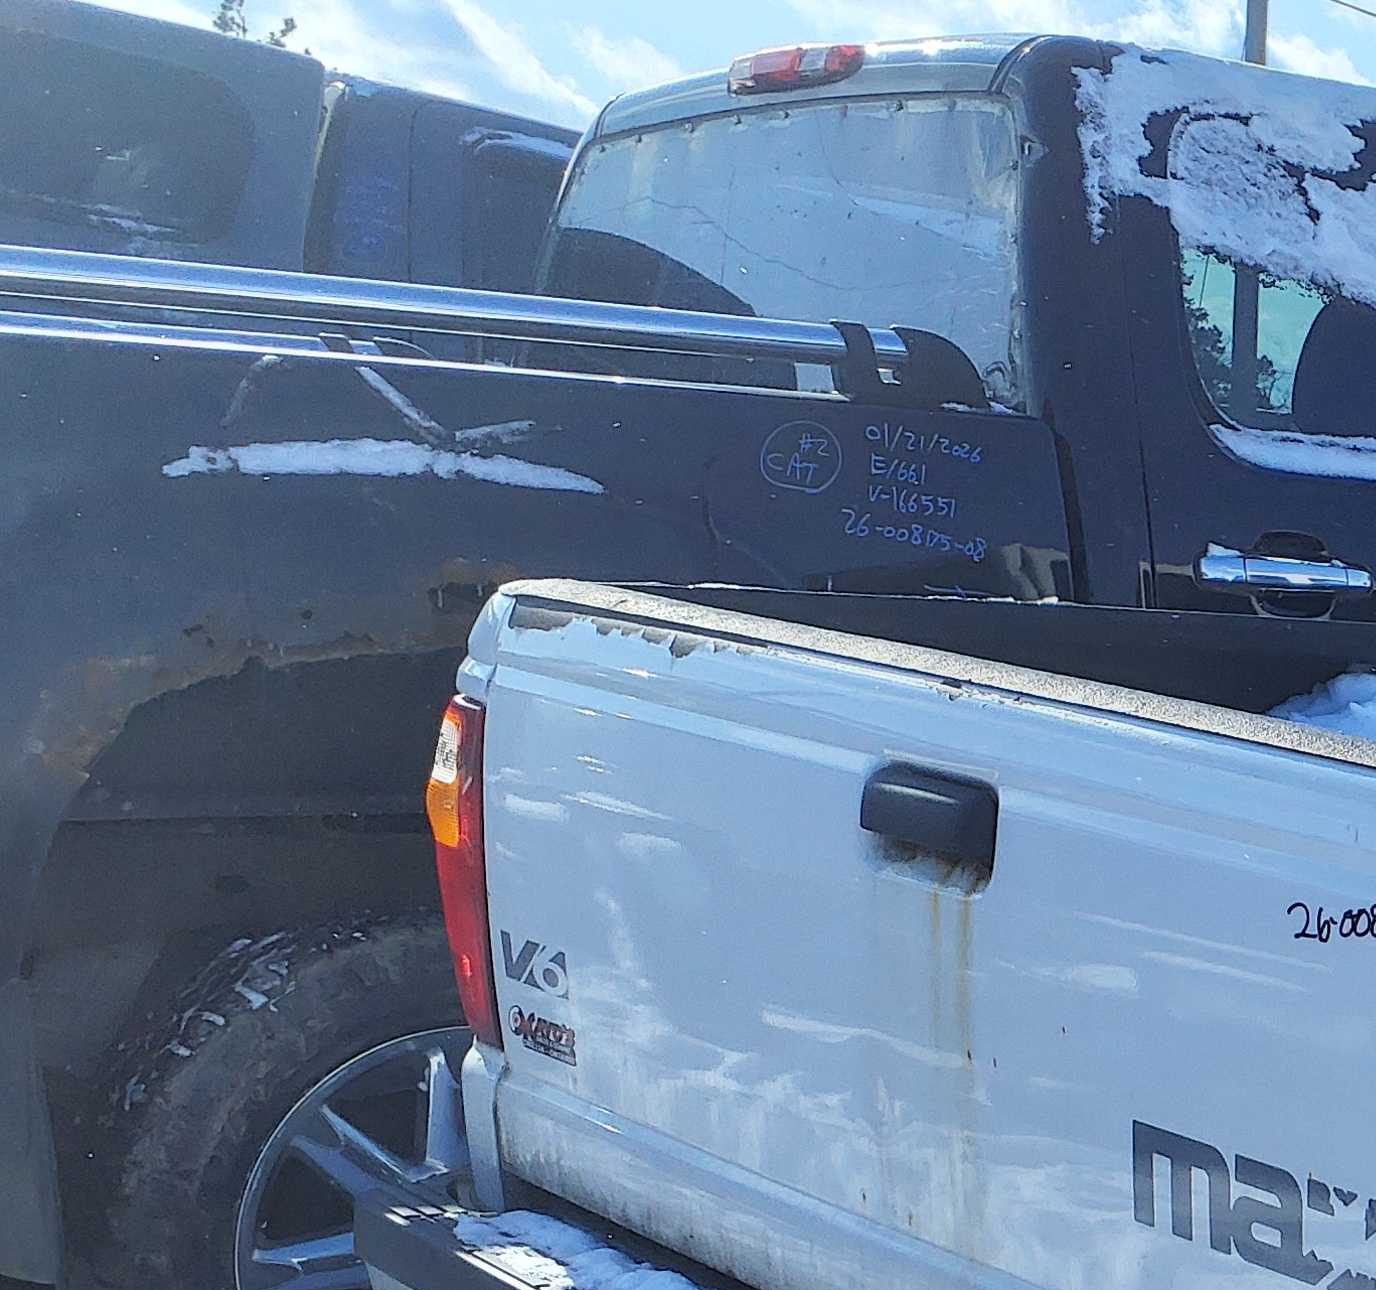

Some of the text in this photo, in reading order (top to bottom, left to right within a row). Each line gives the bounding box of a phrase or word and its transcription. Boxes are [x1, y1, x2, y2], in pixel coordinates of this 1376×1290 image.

[865, 423, 982, 464] 01/21/2026
[766, 452, 819, 484] CAT
[500, 929, 570, 1000] V6
